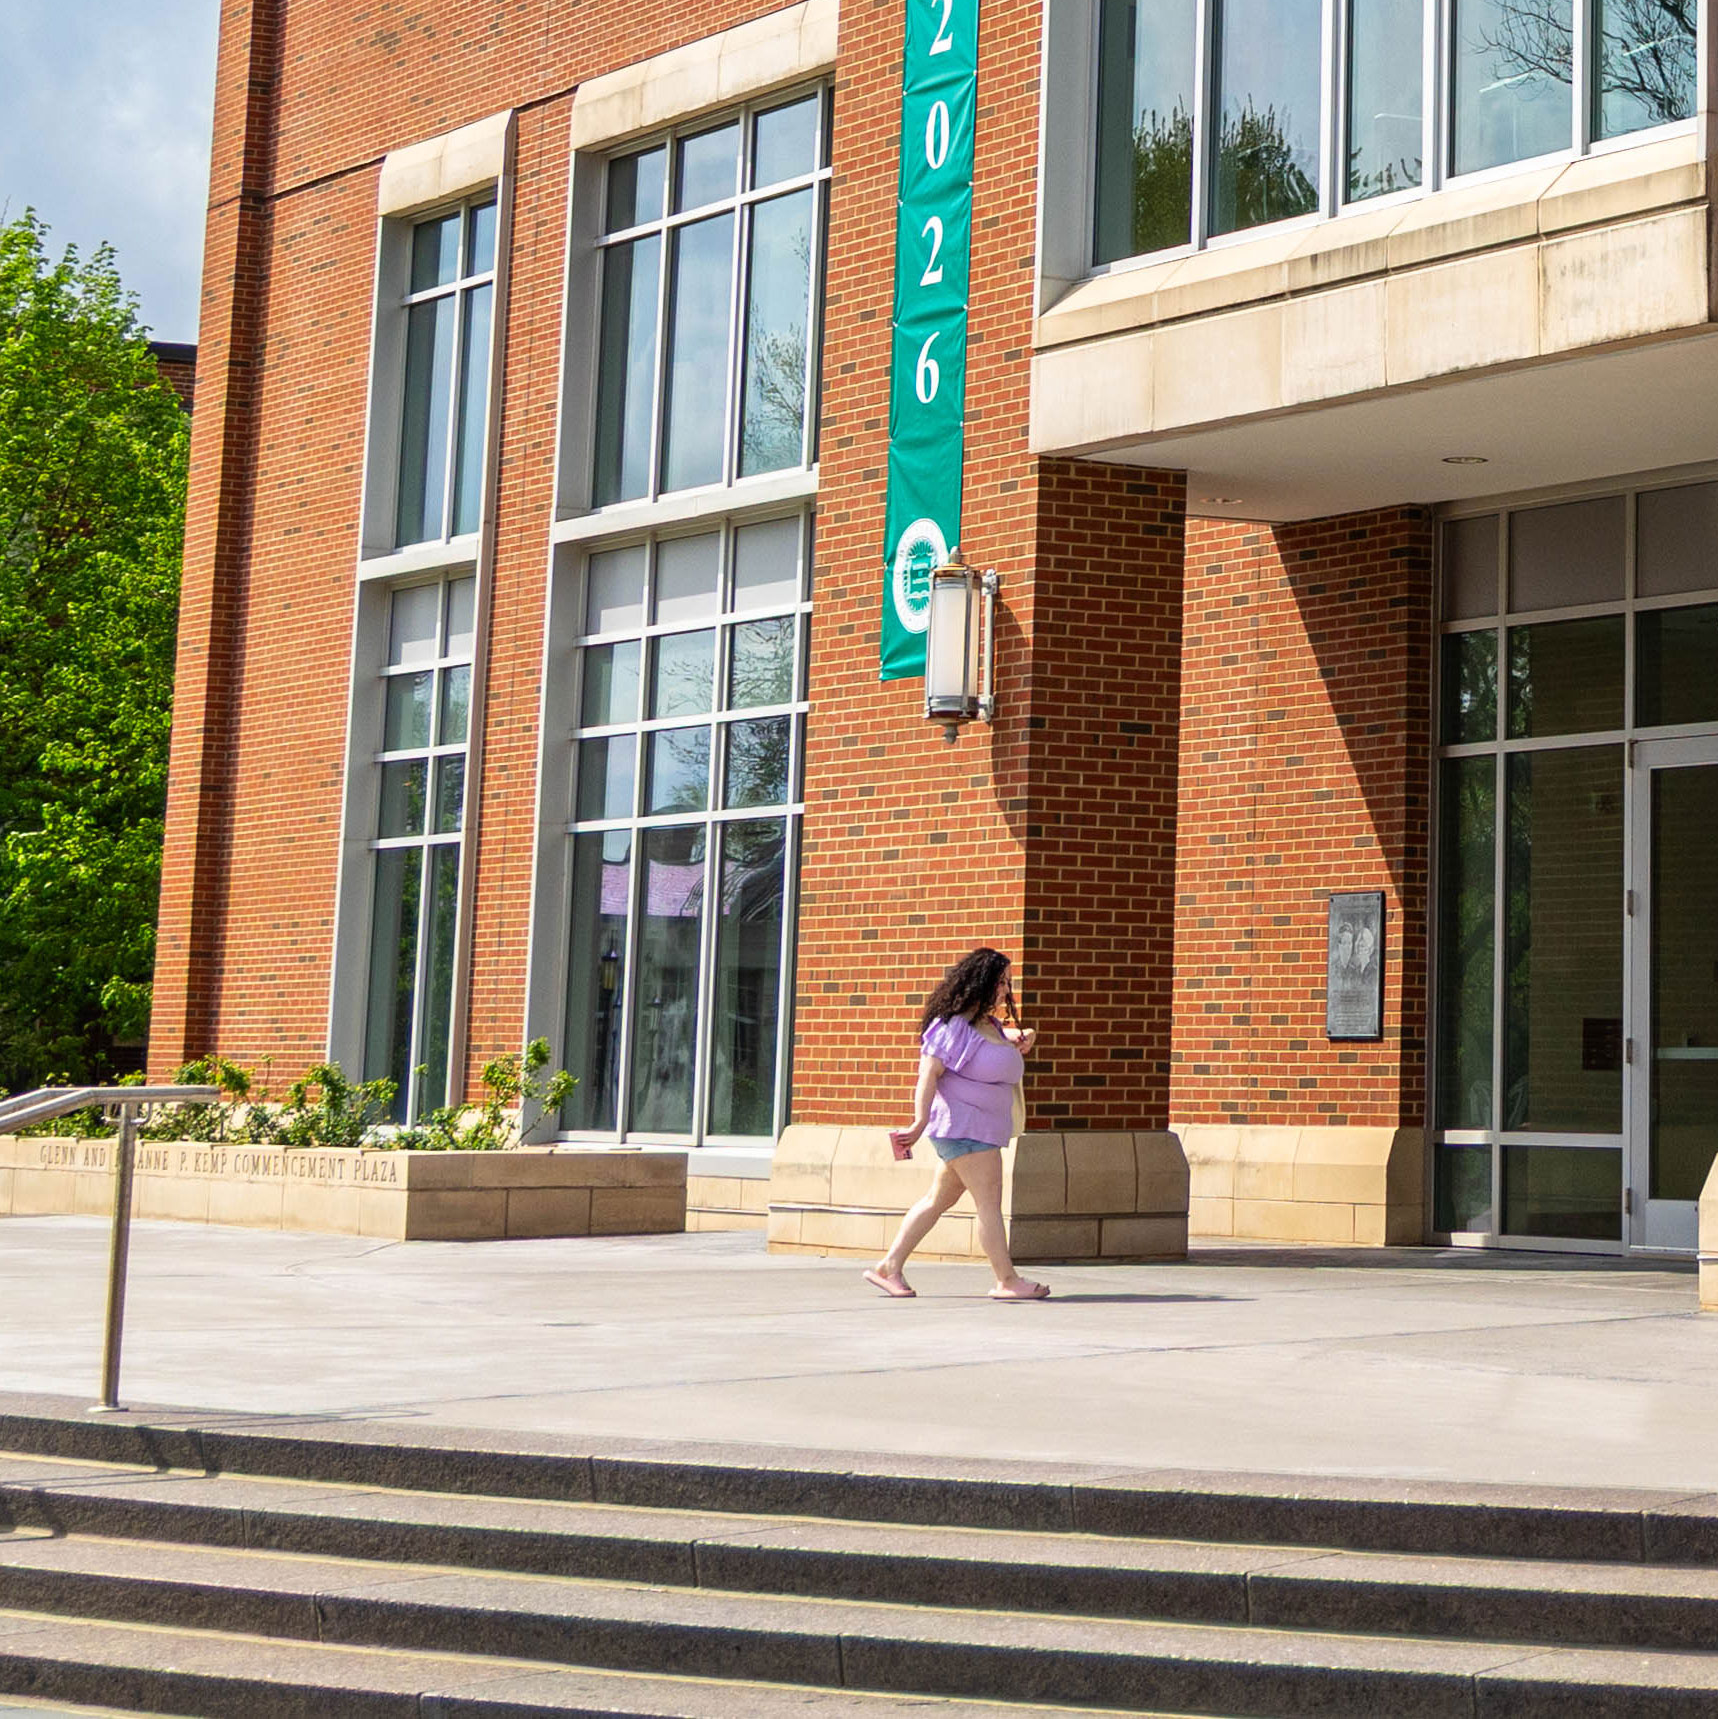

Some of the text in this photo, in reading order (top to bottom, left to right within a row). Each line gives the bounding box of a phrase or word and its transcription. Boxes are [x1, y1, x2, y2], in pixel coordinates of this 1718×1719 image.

[39, 1145, 77, 1165] GLENN
[83, 1147, 106, 1167] AND
[193, 1151, 229, 1174] KEMP
[234, 1153, 346, 1180] COMMENCEMENT
[353, 1158, 397, 1183] PLAZA
